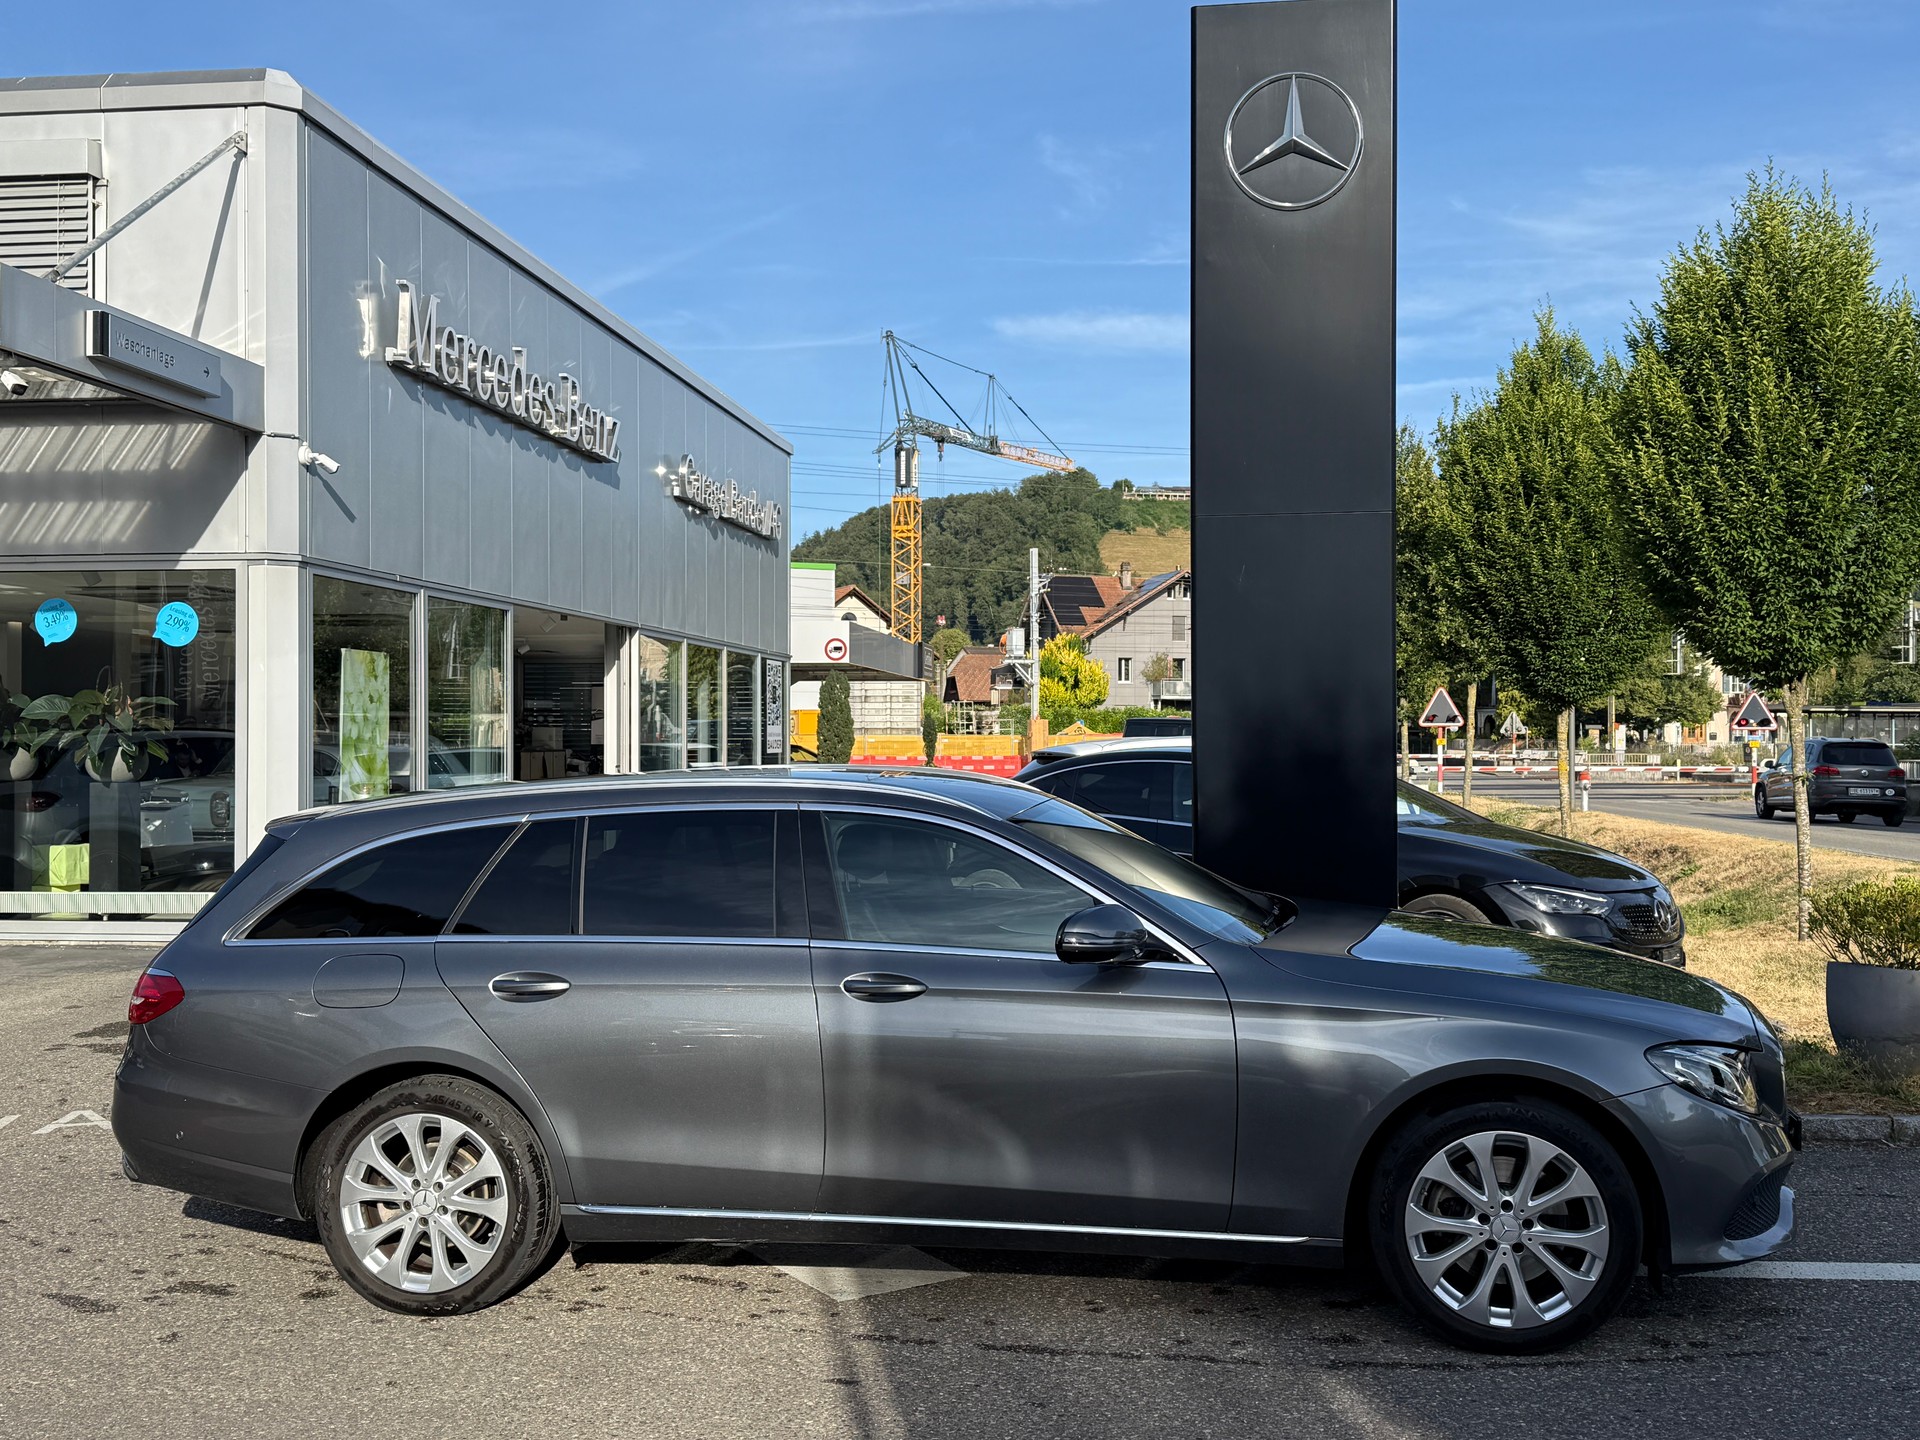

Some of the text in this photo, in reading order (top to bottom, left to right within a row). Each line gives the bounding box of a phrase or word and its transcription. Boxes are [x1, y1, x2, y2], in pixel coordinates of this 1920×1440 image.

[115, 330, 175, 369] Waschanlage
[385, 279, 622, 463] Mercedes-Benz
[678, 453, 727, 519] Garage
[43, 609, 69, 628] 3.49%
[164, 613, 190, 632] 2.99%
[169, 605, 188, 618] Leasing
[424, 1093, 462, 1110] 245/45
[463, 1105, 472, 1113] R
[472, 1110, 484, 1122] 18
